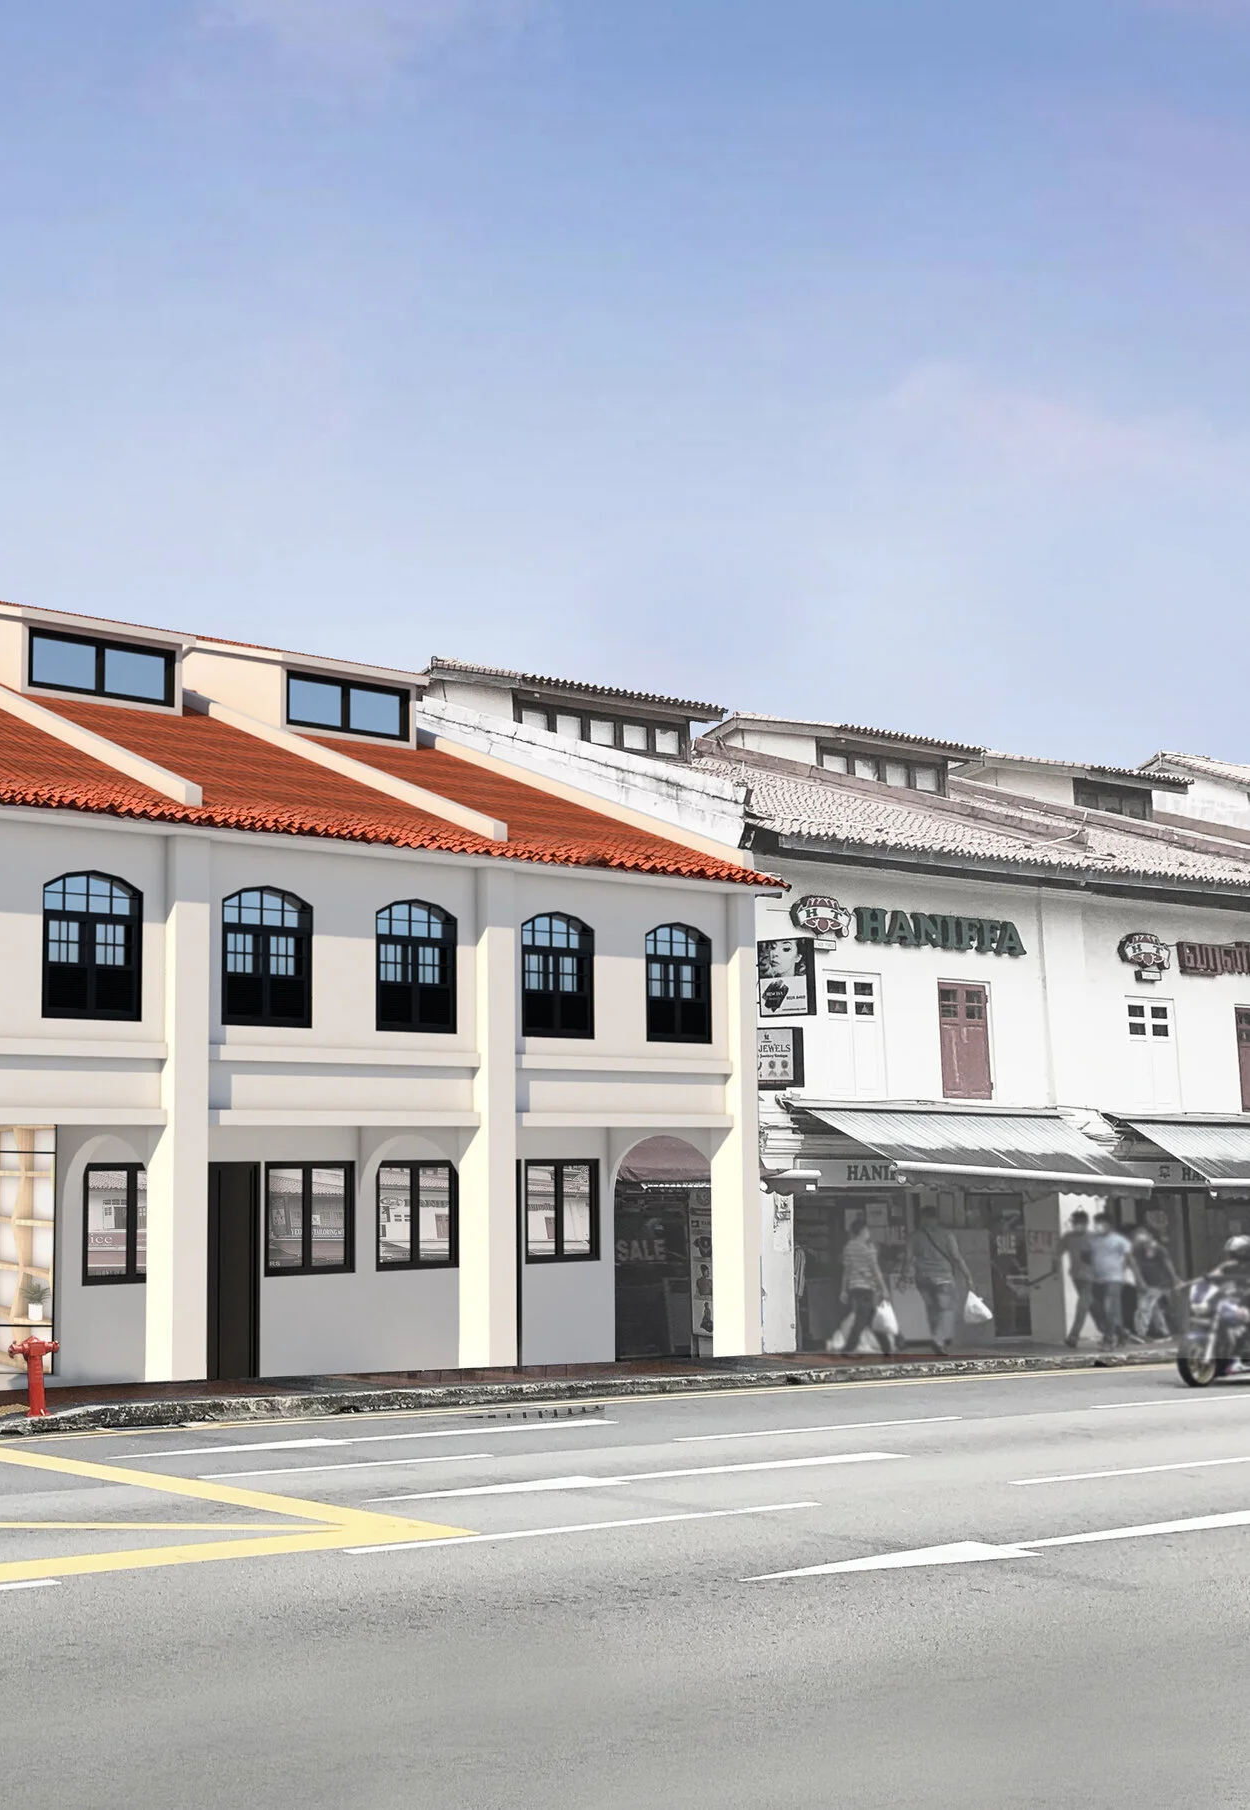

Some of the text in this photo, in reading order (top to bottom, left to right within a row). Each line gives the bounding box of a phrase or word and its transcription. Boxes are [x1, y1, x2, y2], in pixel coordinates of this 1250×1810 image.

[854, 906, 1027, 957] HANIFFA
[758, 1044, 792, 1053] JEWELS
[616, 1239, 667, 1261] SALE
